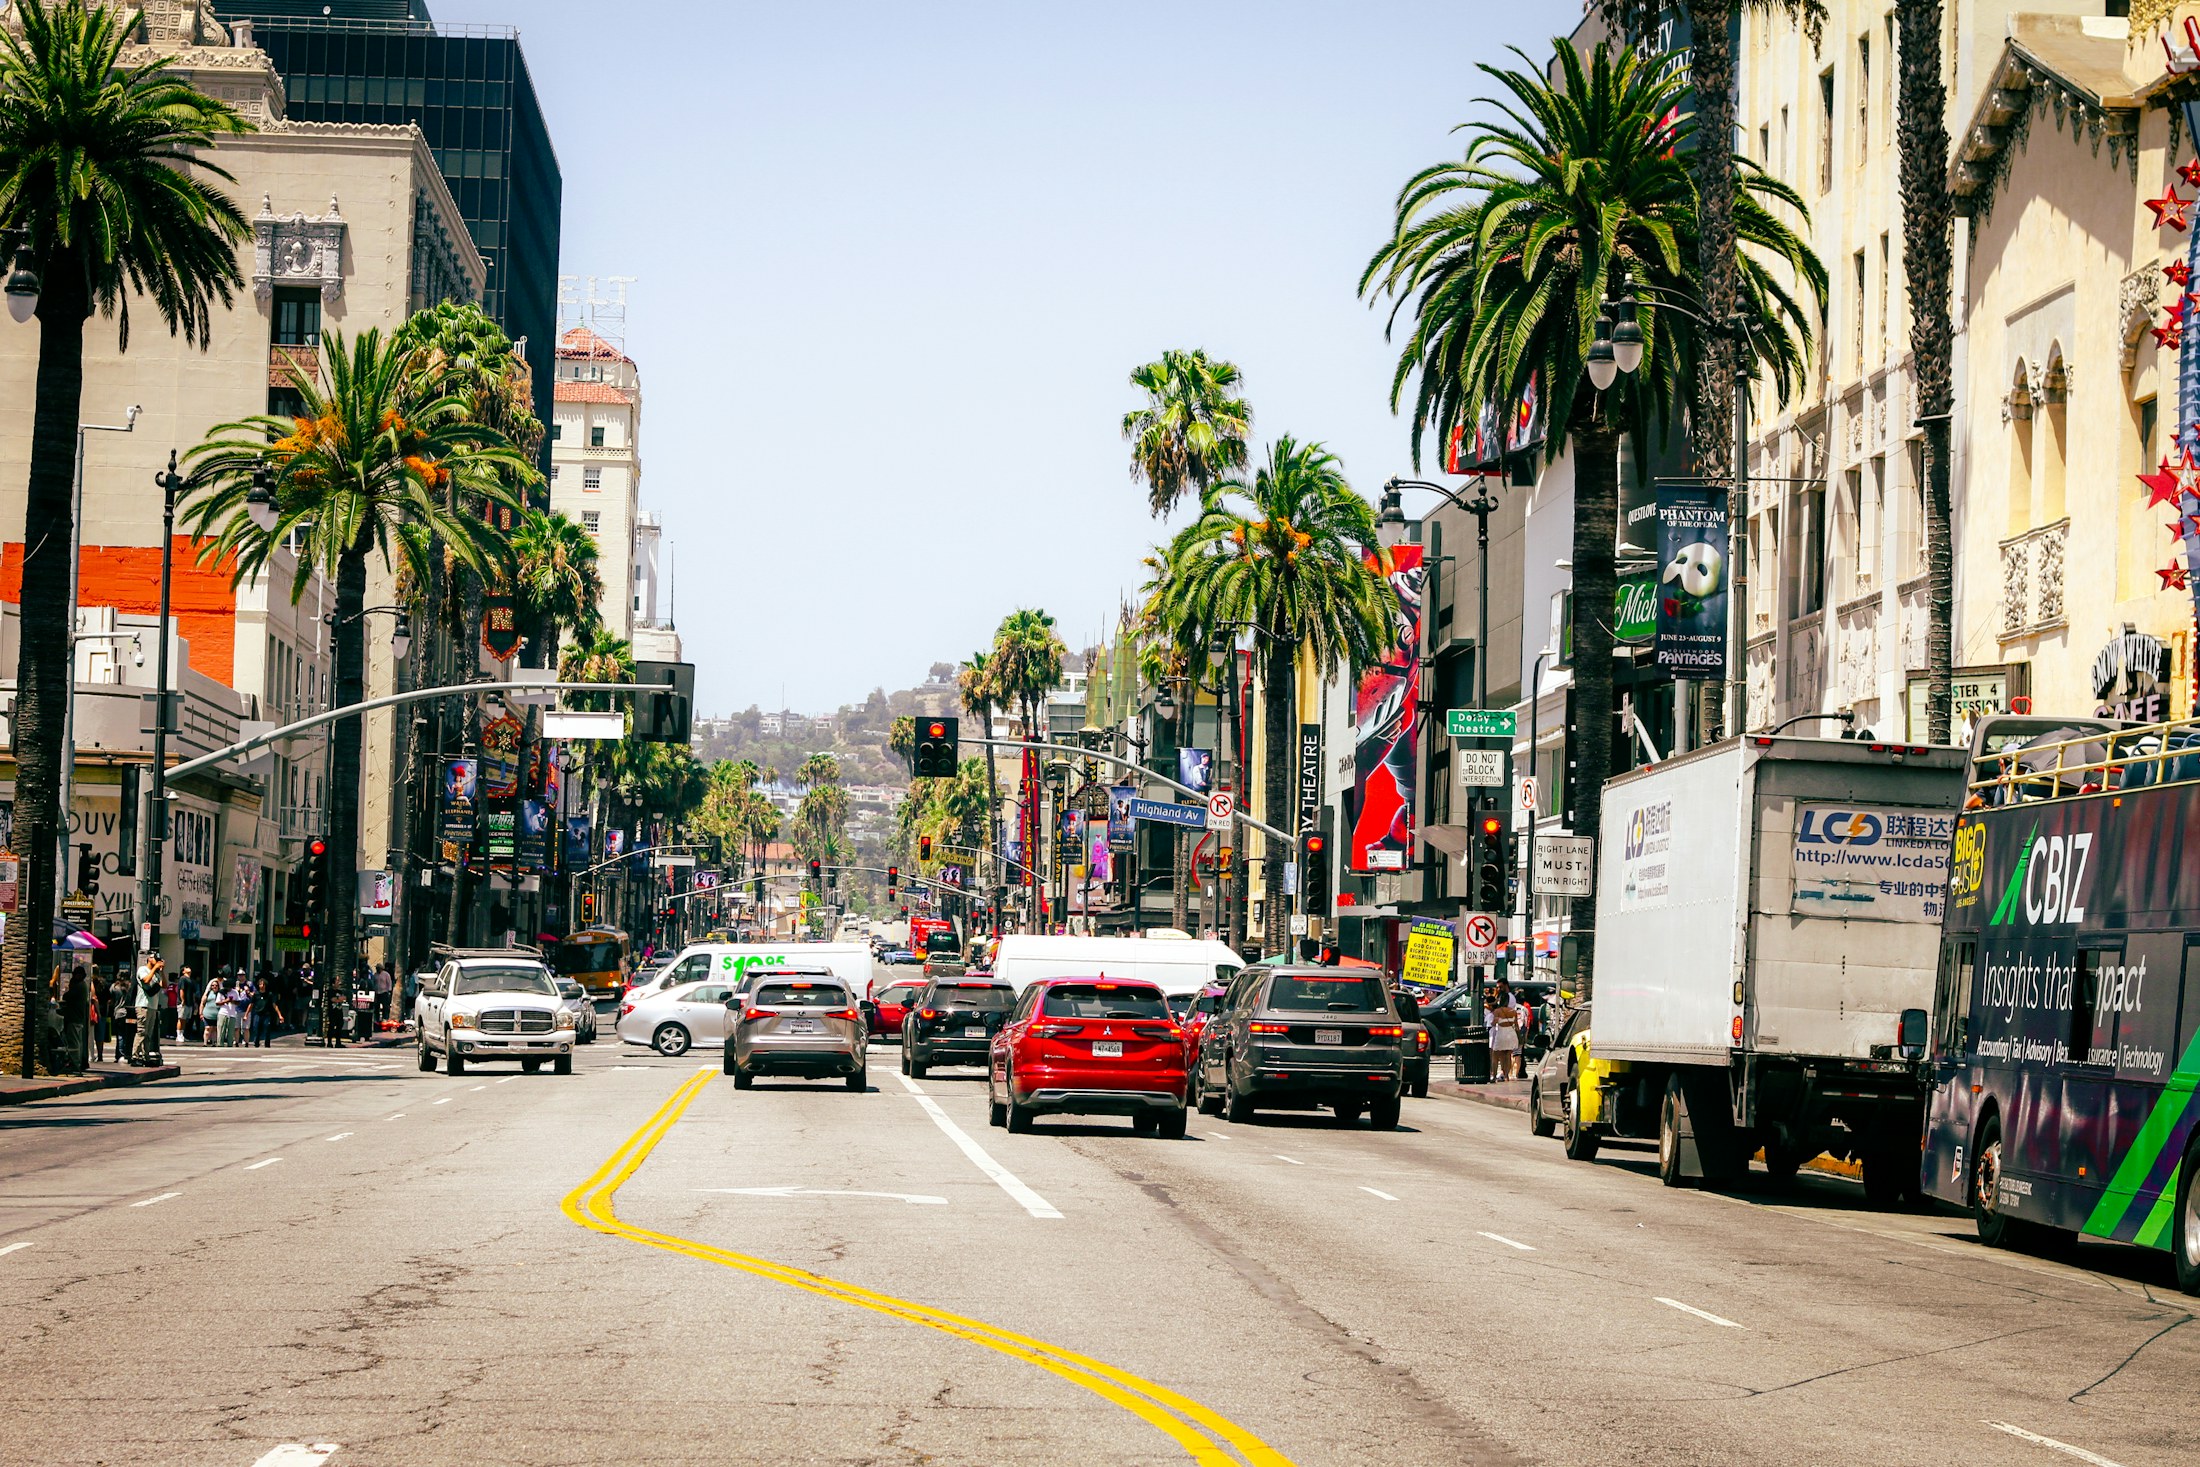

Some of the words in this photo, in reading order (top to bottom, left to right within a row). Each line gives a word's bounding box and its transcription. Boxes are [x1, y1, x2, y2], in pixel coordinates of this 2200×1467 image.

[1659, 509, 1725, 522] PHANTOM
[1693, 521, 1718, 529] OPERA
[1660, 634, 1677, 642] JUNE
[1658, 651, 1723, 666] PANTAGES
[2091, 638, 2119, 695] SNOW
[2125, 633, 2163, 683] WHITE
[1952, 684, 1979, 698] STER
[1990, 683, 1997, 696] 4
[1452, 724, 1497, 734] Theatre
[1466, 754, 1477, 763] DO
[1482, 754, 1498, 764] NOT
[1301, 735, 1318, 813] THEATRE
[1468, 765, 1496, 775] BLOCK
[1136, 803, 1181, 818] Highland
[1185, 811, 1199, 820] Av
[1798, 810, 1883, 846] LCD
[1886, 814, 1955, 838] 联程达
[1538, 845, 1563, 854] RIGHT
[1566, 846, 1588, 854] LANE
[1886, 839, 1932, 850] LINKEDA
[1955, 826, 1973, 863] BIG
[941, 853, 954, 861] PED
[957, 857, 972, 865] XING
[1369, 855, 1377, 864] M
[1543, 861, 1582, 871] MUST
[1537, 876, 1559, 885] TURN
[1563, 878, 1588, 887] RIGHT
[2025, 832, 2093, 925] CBIZ
[181, 920, 199, 930] ATM
[1412, 926, 1435, 935] RECEIVED
[1467, 952, 1478, 960] ON
[1982, 951, 2040, 1024] Insights
[2044, 951, 2076, 1012] that
[1317, 1034, 1340, 1042] 9YDX187
[1976, 1035, 2009, 1063] Accounting
[2011, 1036, 2022, 1061] Tax
[2025, 1035, 2052, 1066] Advisory
[2122, 1044, 2165, 1076] Technology
